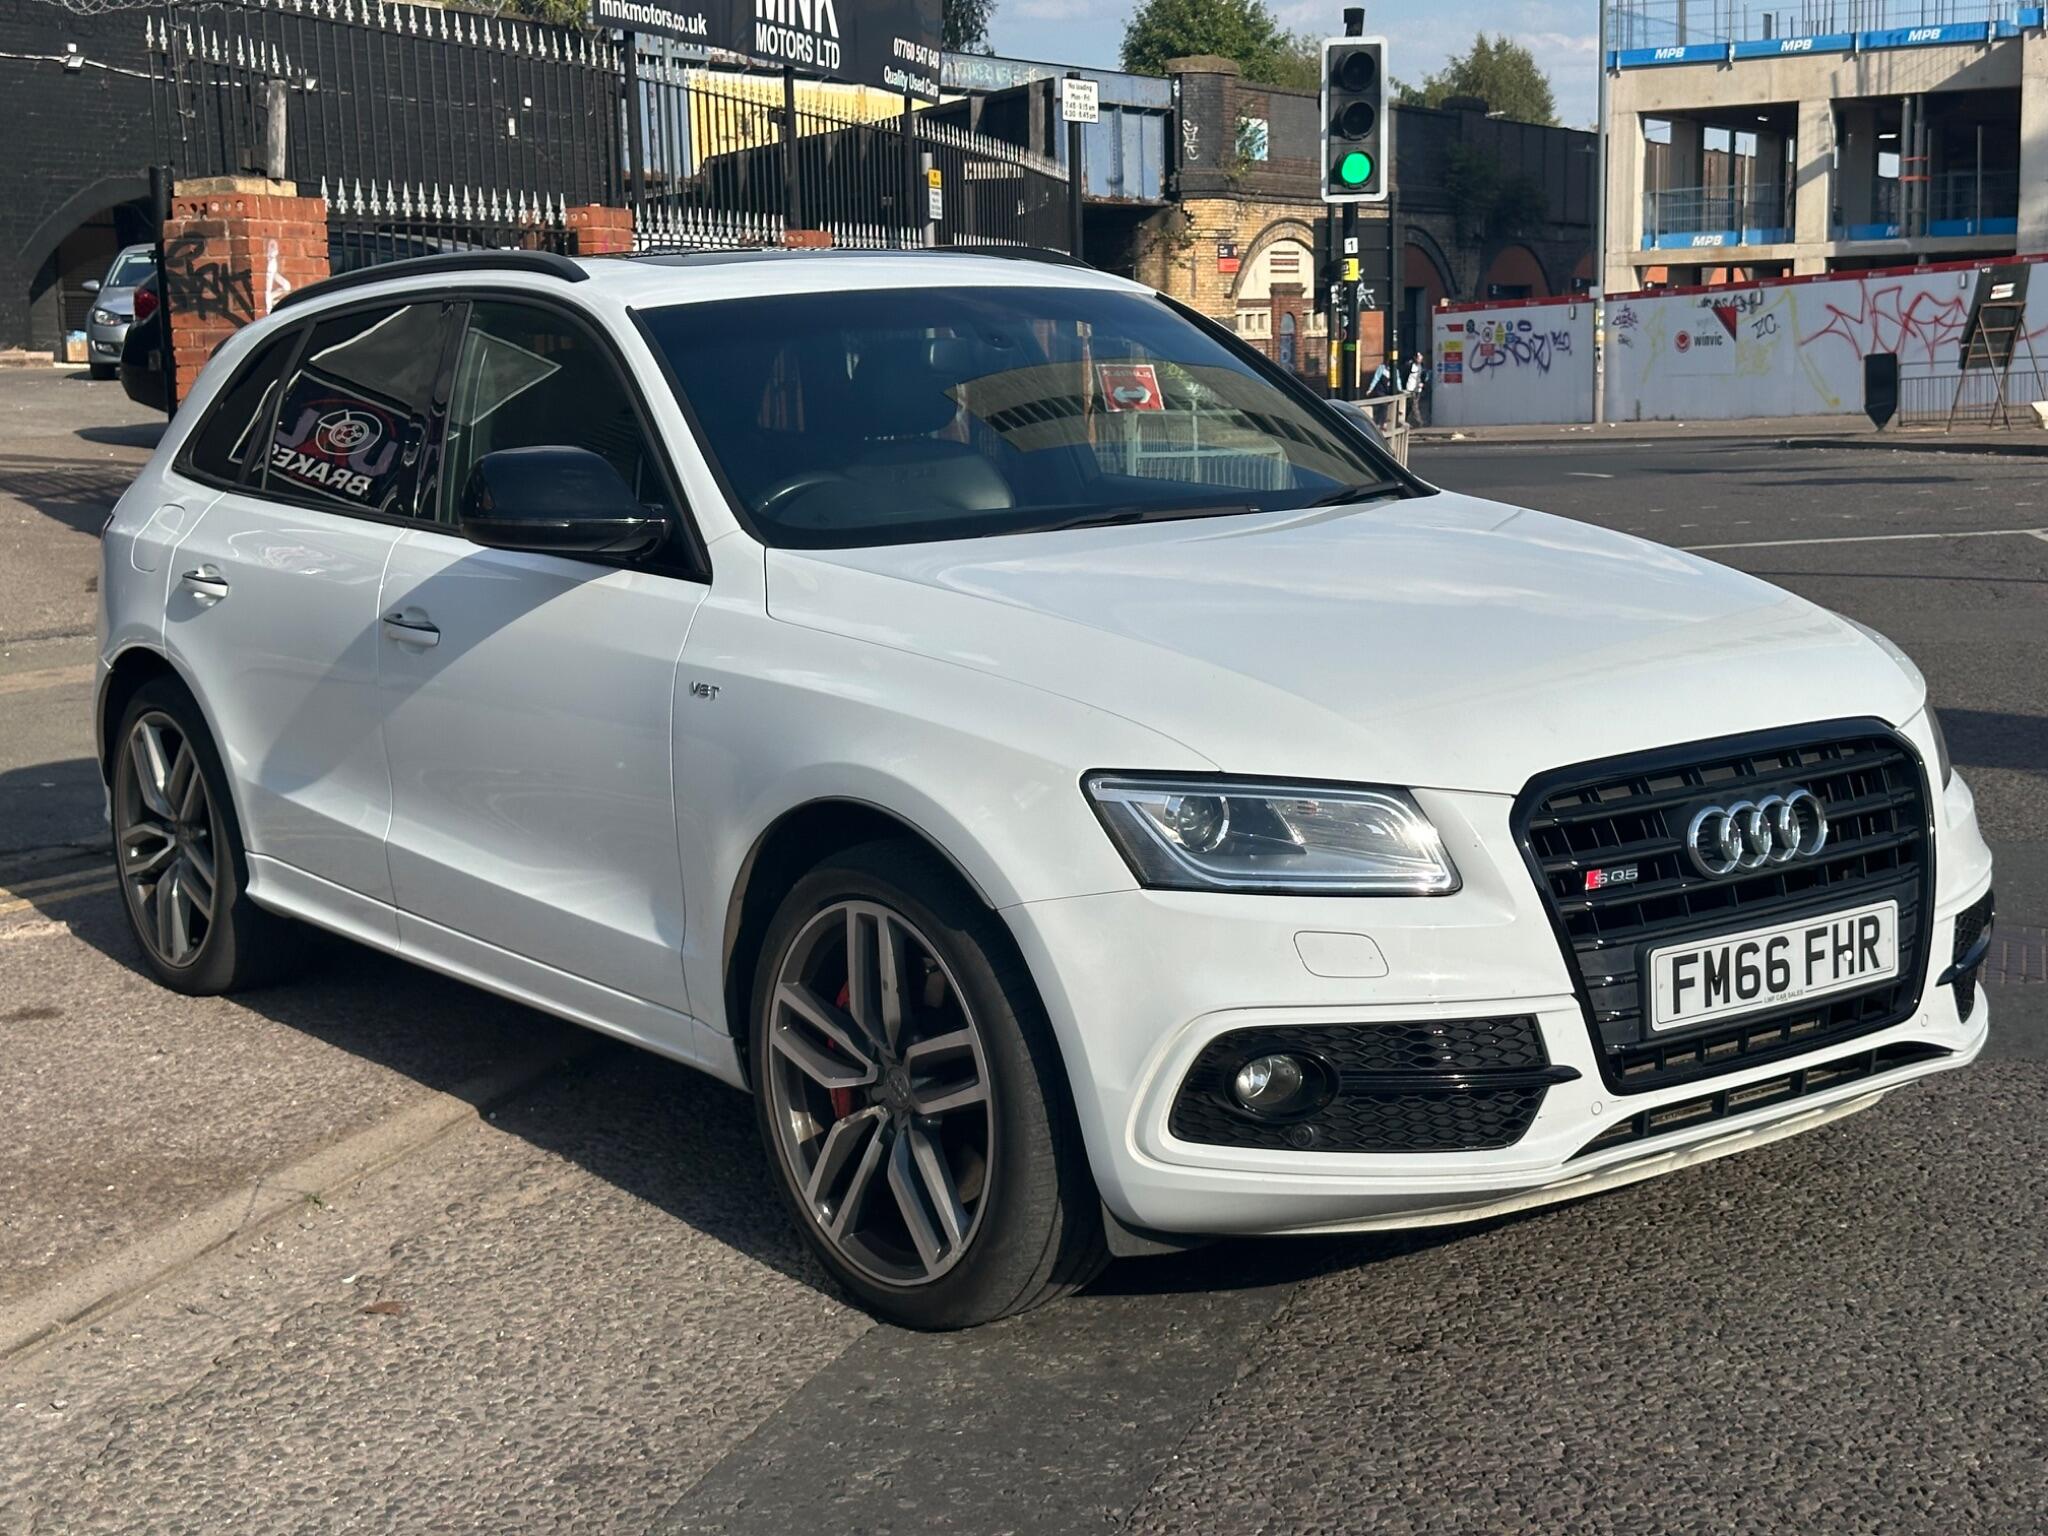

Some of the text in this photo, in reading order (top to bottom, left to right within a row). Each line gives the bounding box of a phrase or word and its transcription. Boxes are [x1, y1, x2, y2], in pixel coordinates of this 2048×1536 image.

[599, 0, 707, 36] mnkmotors.co.uk
[1907, 28, 1941, 42] MPB
[756, 22, 840, 70] MOTORS LTD
[1654, 46, 1685, 60] MPB
[1780, 39, 1813, 52] MPB
[884, 65, 939, 98] Quality Used Cars
[1347, 240, 1354, 251] 1
[1691, 235, 1722, 247] MPB
[1693, 331, 1723, 347] winvic
[1595, 868, 1639, 884] SQ5
[1672, 915, 1881, 1015] FM66 FHR
[1776, 993, 1786, 1001] CAR
[1787, 989, 1803, 999] SALES
